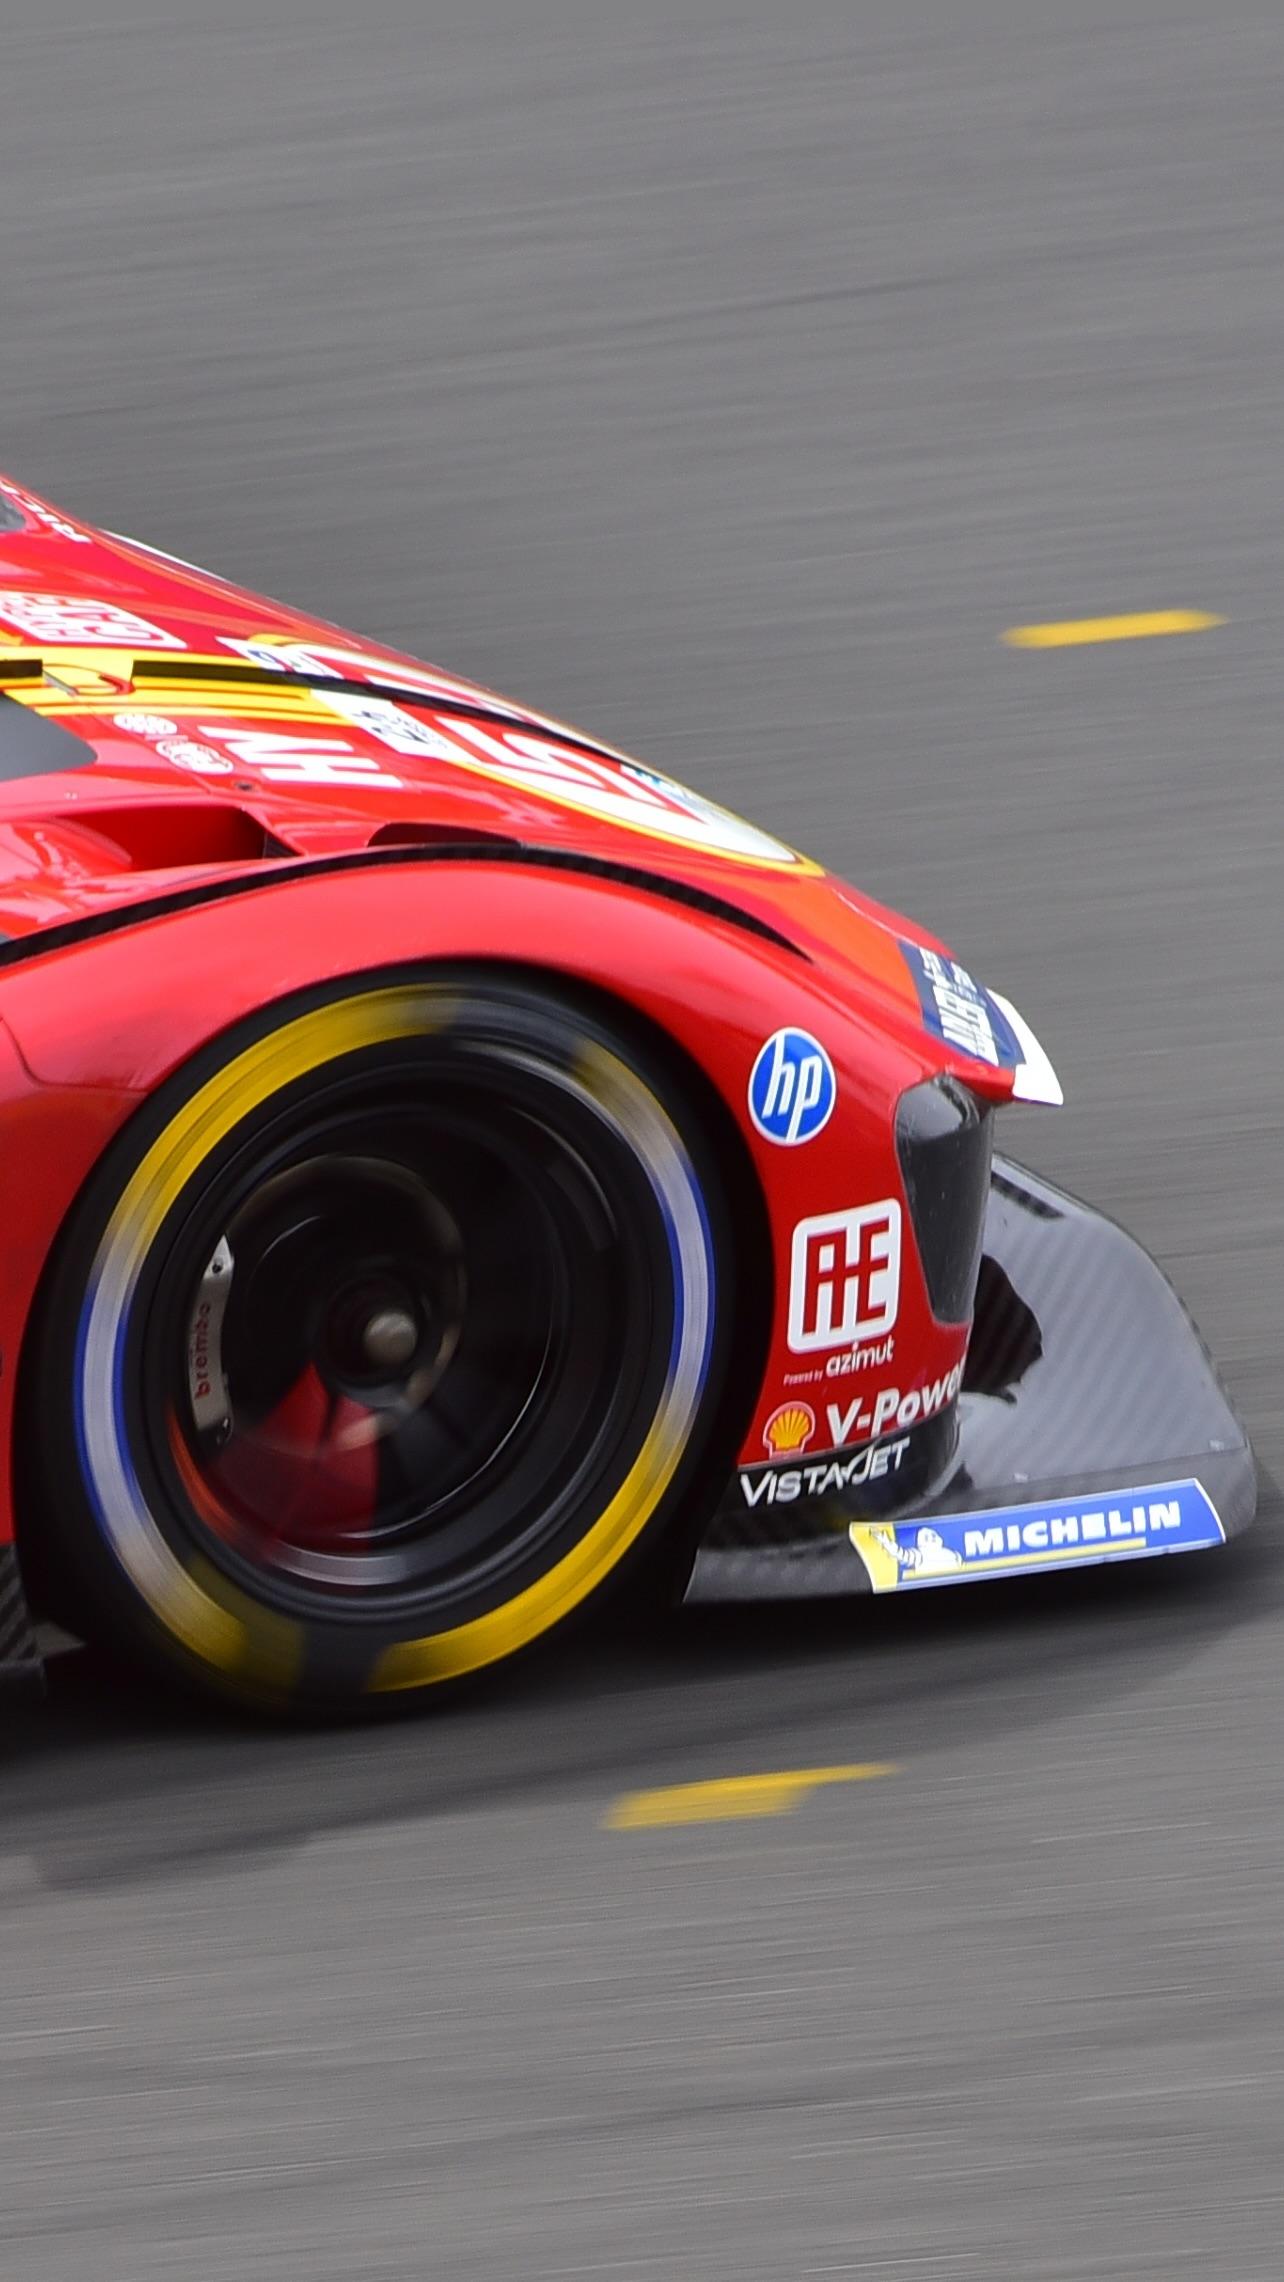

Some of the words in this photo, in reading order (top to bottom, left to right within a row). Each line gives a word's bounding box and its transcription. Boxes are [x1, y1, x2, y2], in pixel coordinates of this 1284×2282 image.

[760, 1031, 823, 1143] hp
[194, 1302, 212, 1399] brembo
[826, 1334, 896, 1378] azimut
[826, 1358, 965, 1449] V-Powe
[740, 1436, 910, 1507] VISTAJET
[963, 1500, 1182, 1557] MICHELIN
